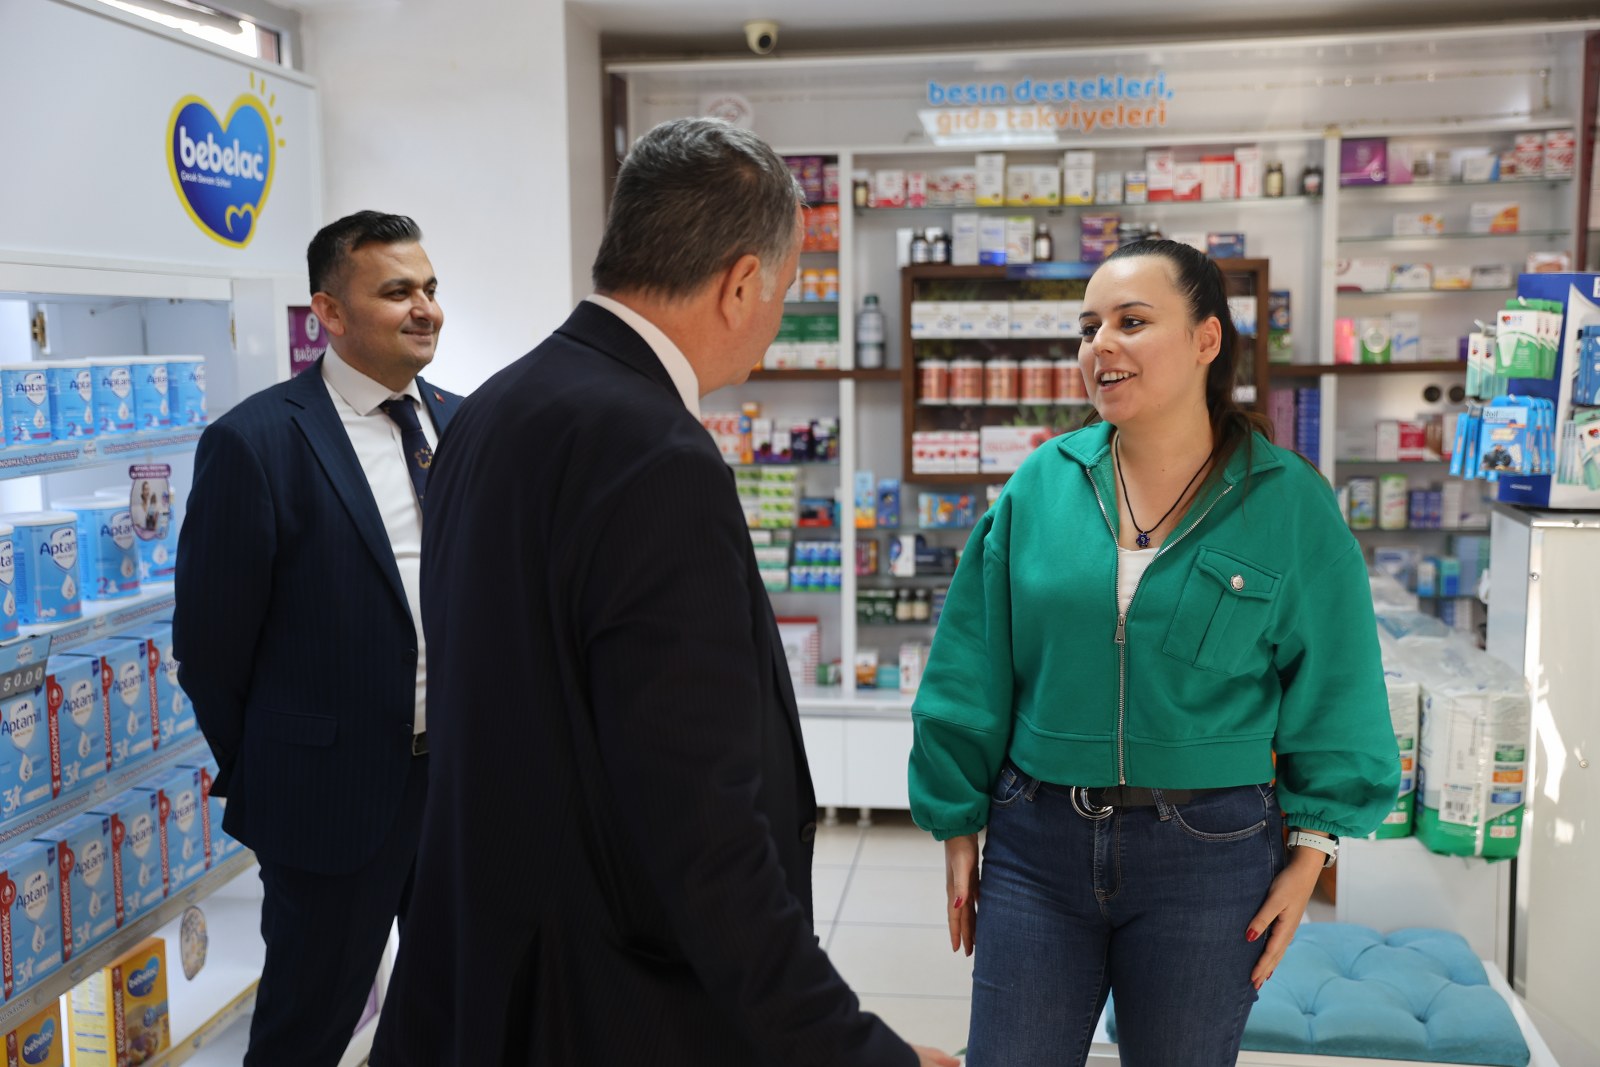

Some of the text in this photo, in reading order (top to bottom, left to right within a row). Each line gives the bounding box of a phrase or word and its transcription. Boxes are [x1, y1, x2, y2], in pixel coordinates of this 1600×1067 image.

[1006, 101, 1166, 132] takviyeleri
[180, 125, 264, 182] bebelac
[63, 688, 99, 715] Aptamil
[1, 707, 42, 736] Aptamil
[15, 878, 55, 910] Aptamil
[2, 912, 13, 977] EKONOMİK
